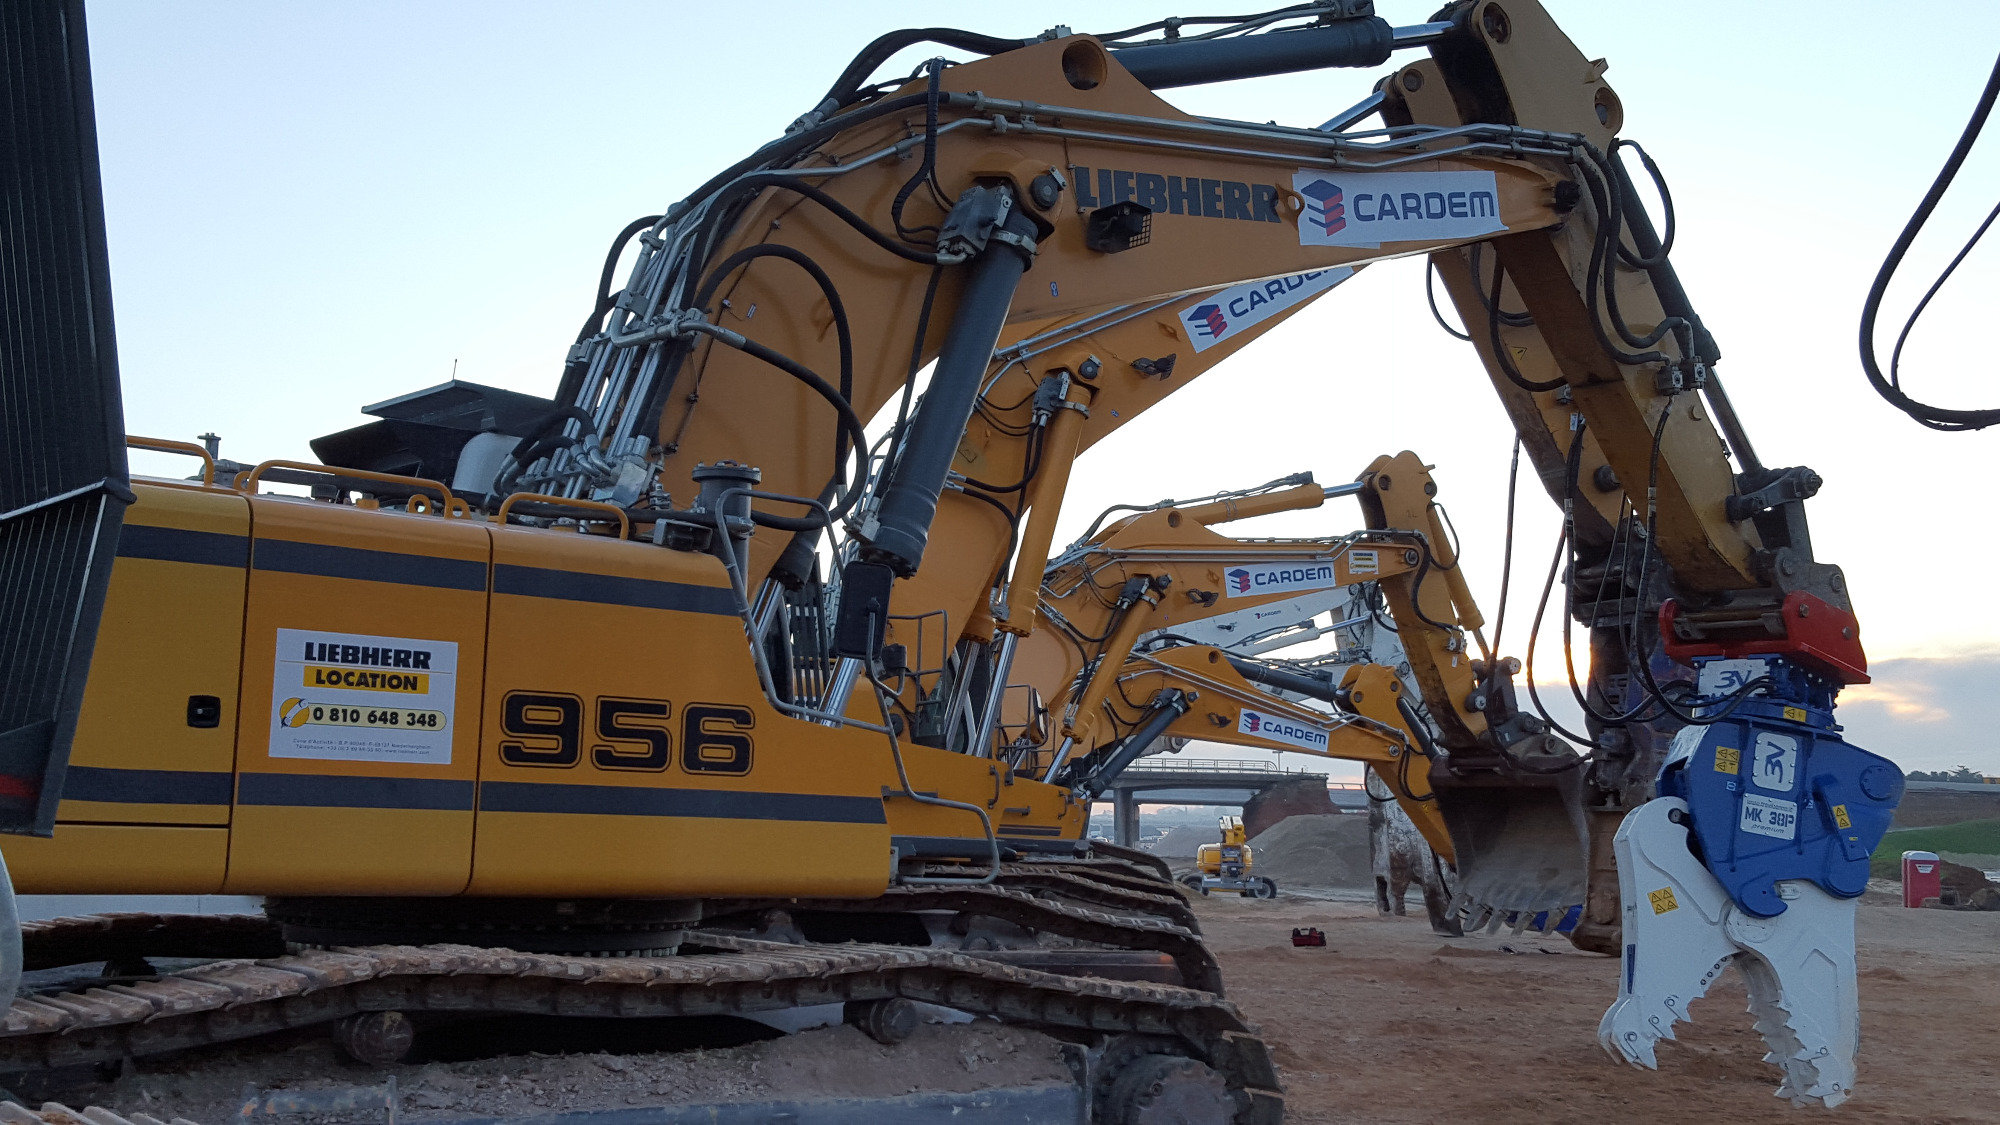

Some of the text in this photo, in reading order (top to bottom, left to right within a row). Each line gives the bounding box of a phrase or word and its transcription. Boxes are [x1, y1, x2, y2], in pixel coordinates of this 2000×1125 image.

[1074, 166, 1282, 223] LIEBHERR
[1353, 191, 1496, 222] CARDEM
[1228, 269, 1330, 318] CARD
[1254, 566, 1332, 586] CARDEM
[304, 641, 432, 670] LIEBHERR
[315, 669, 419, 691] LOCATION
[313, 707, 438, 728] 0 810 648 348
[498, 688, 756, 777] 956
[1263, 721, 1327, 745] CARDEM
[1744, 806, 1795, 827] MK 38P
[1751, 823, 1785, 834] premium
